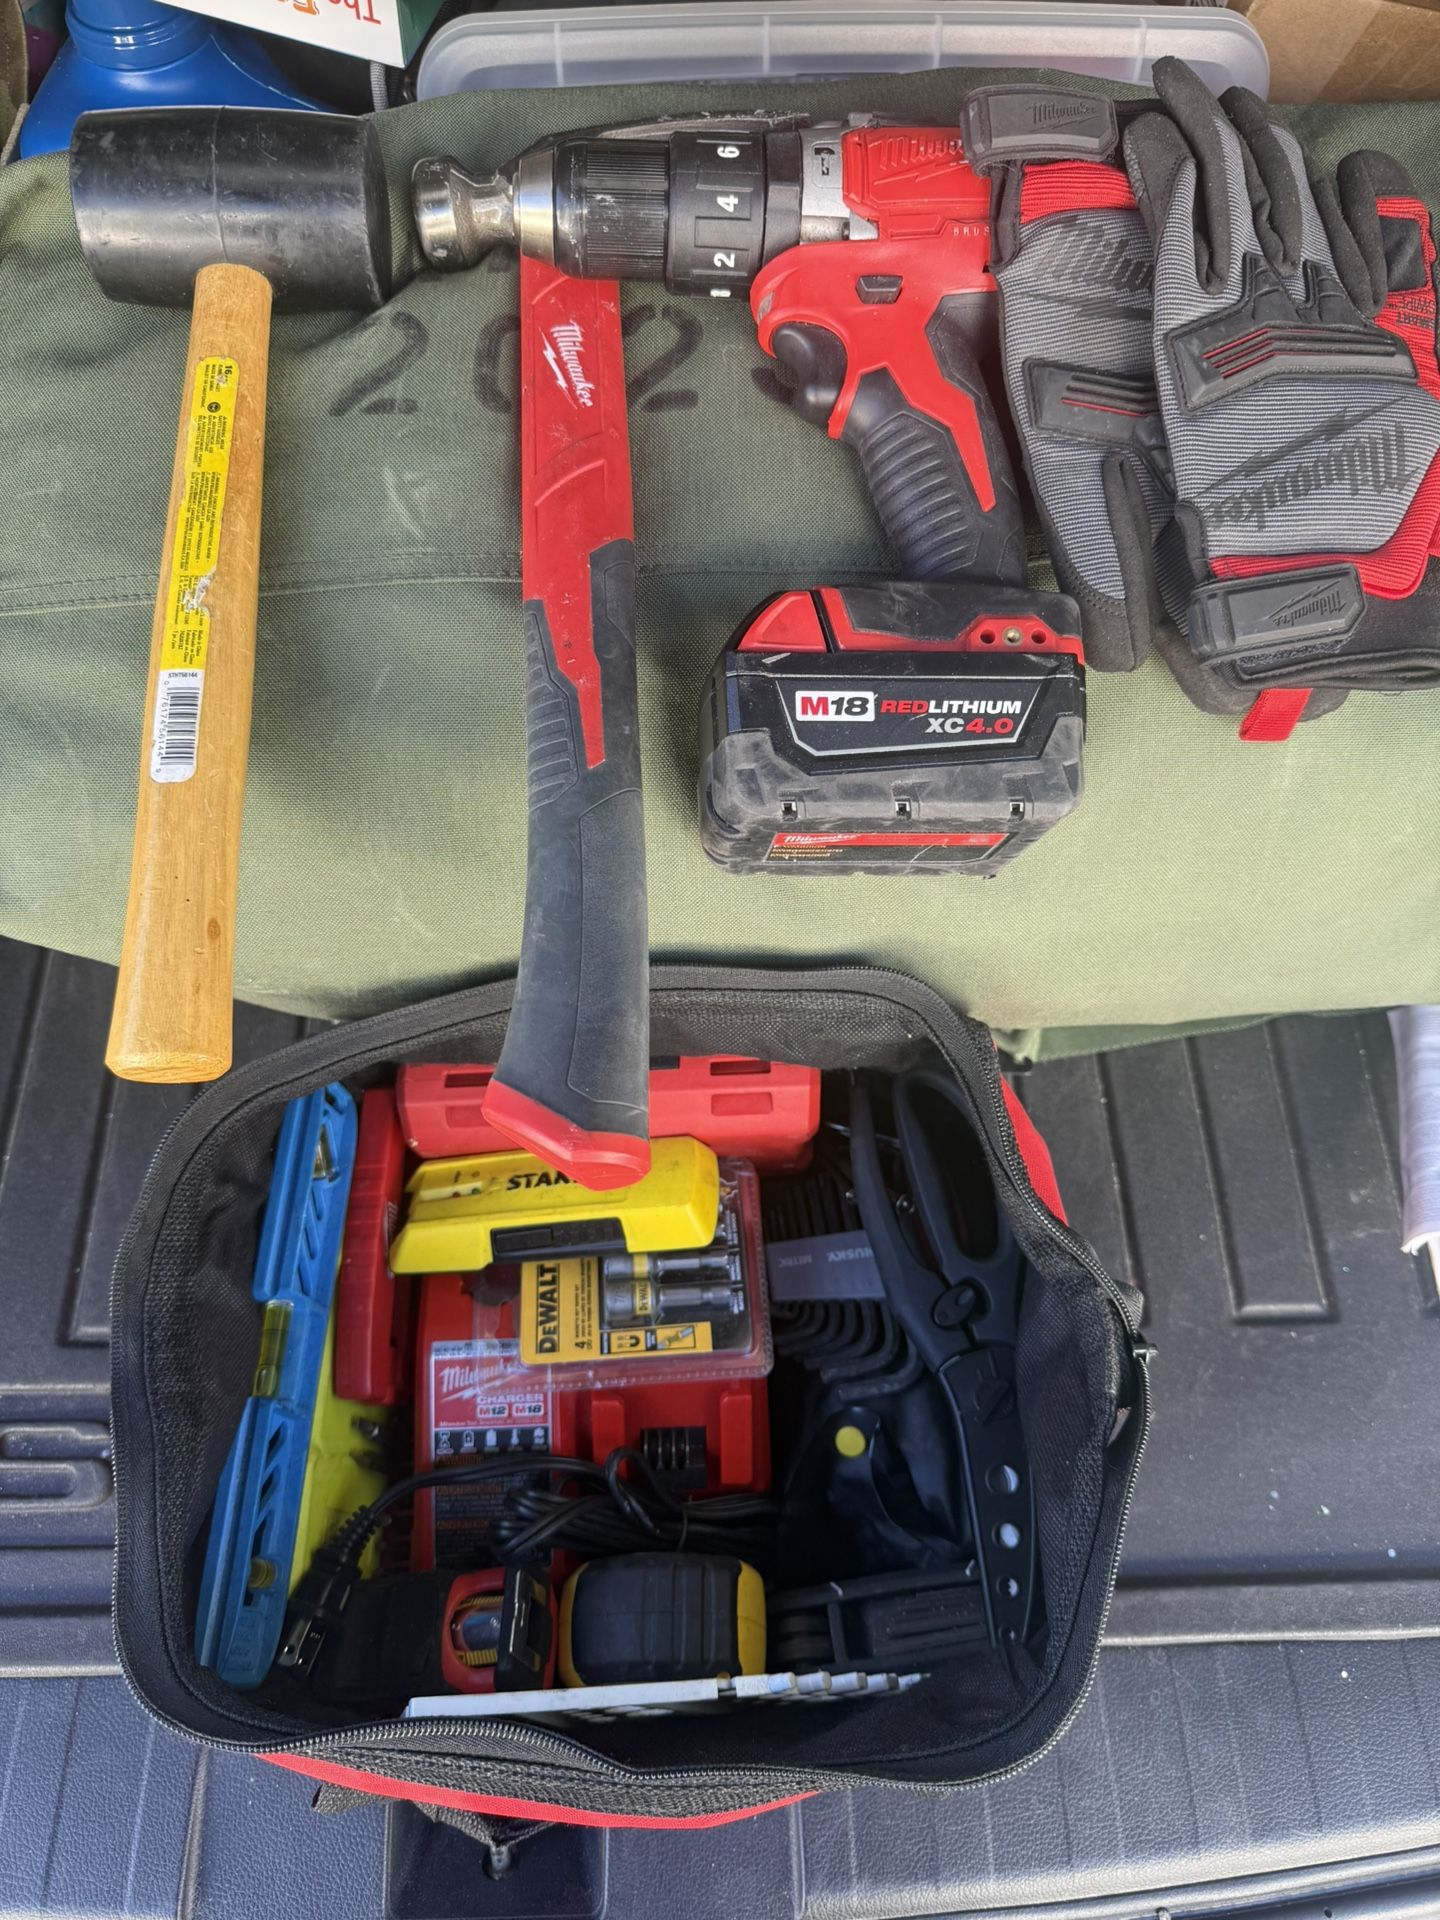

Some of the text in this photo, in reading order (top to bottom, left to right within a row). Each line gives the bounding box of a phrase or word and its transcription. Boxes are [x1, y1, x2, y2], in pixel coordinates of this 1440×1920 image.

[1025, 102, 1097, 124] Milwaukee
[717, 145, 740, 159] 6
[868, 136, 964, 170] Milwa
[717, 193, 739, 213] 4
[953, 226, 991, 237] BRUS
[713, 253, 735, 268] 2
[549, 317, 595, 409] Milwaukee
[1199, 420, 1420, 532] Milwaukee
[1272, 590, 1348, 627] Milwaukee
[801, 696, 1023, 717] M18 REDLITHIUM
[924, 716, 1014, 735] XC4.0
[506, 1170, 578, 1191] STAN
[574, 1340, 588, 1350] 4
[476, 1393, 545, 1404] CHARGER
[477, 1403, 543, 1417] M12 M18
